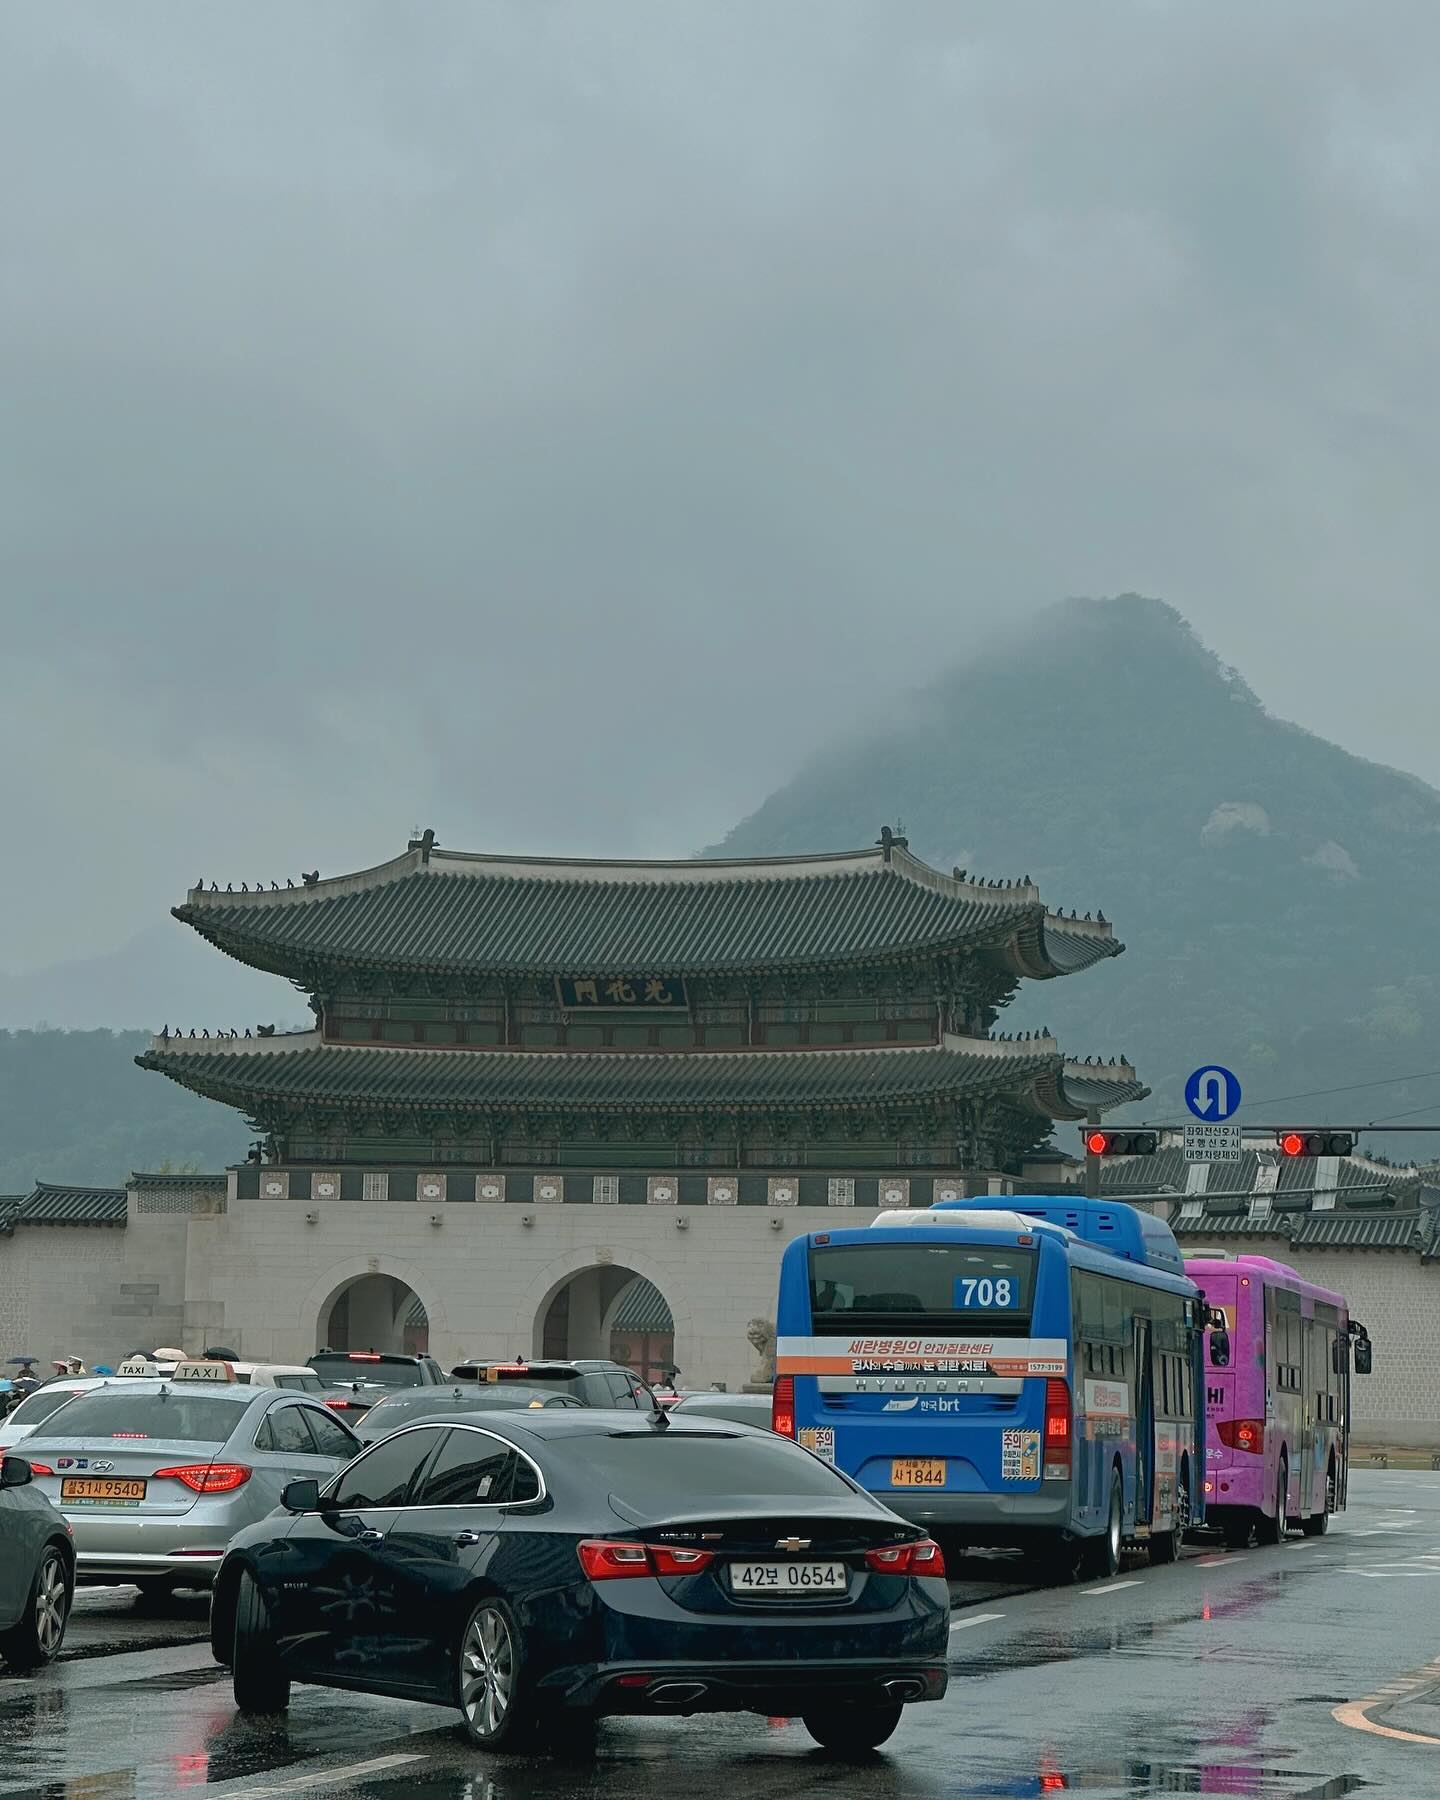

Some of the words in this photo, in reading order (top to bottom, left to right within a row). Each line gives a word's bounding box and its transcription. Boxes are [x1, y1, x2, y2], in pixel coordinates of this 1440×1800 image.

[962, 1279, 1011, 1307] 708
[848, 1340, 921, 1354] 세란병원의
[123, 1366, 145, 1375] TAXI
[923, 1359, 935, 1371] 눈
[961, 1360, 987, 1371] 치료!
[1029, 1363, 1063, 1371] 1577-3199
[182, 1367, 218, 1379] TAXI
[856, 1379, 984, 1392] HYUNDAI
[816, 1431, 833, 1447] 주의
[1003, 1433, 1022, 1449] 주의
[105, 1482, 140, 1497] 9540
[742, 1566, 779, 1586] 42보
[788, 1566, 836, 1586] 0654
